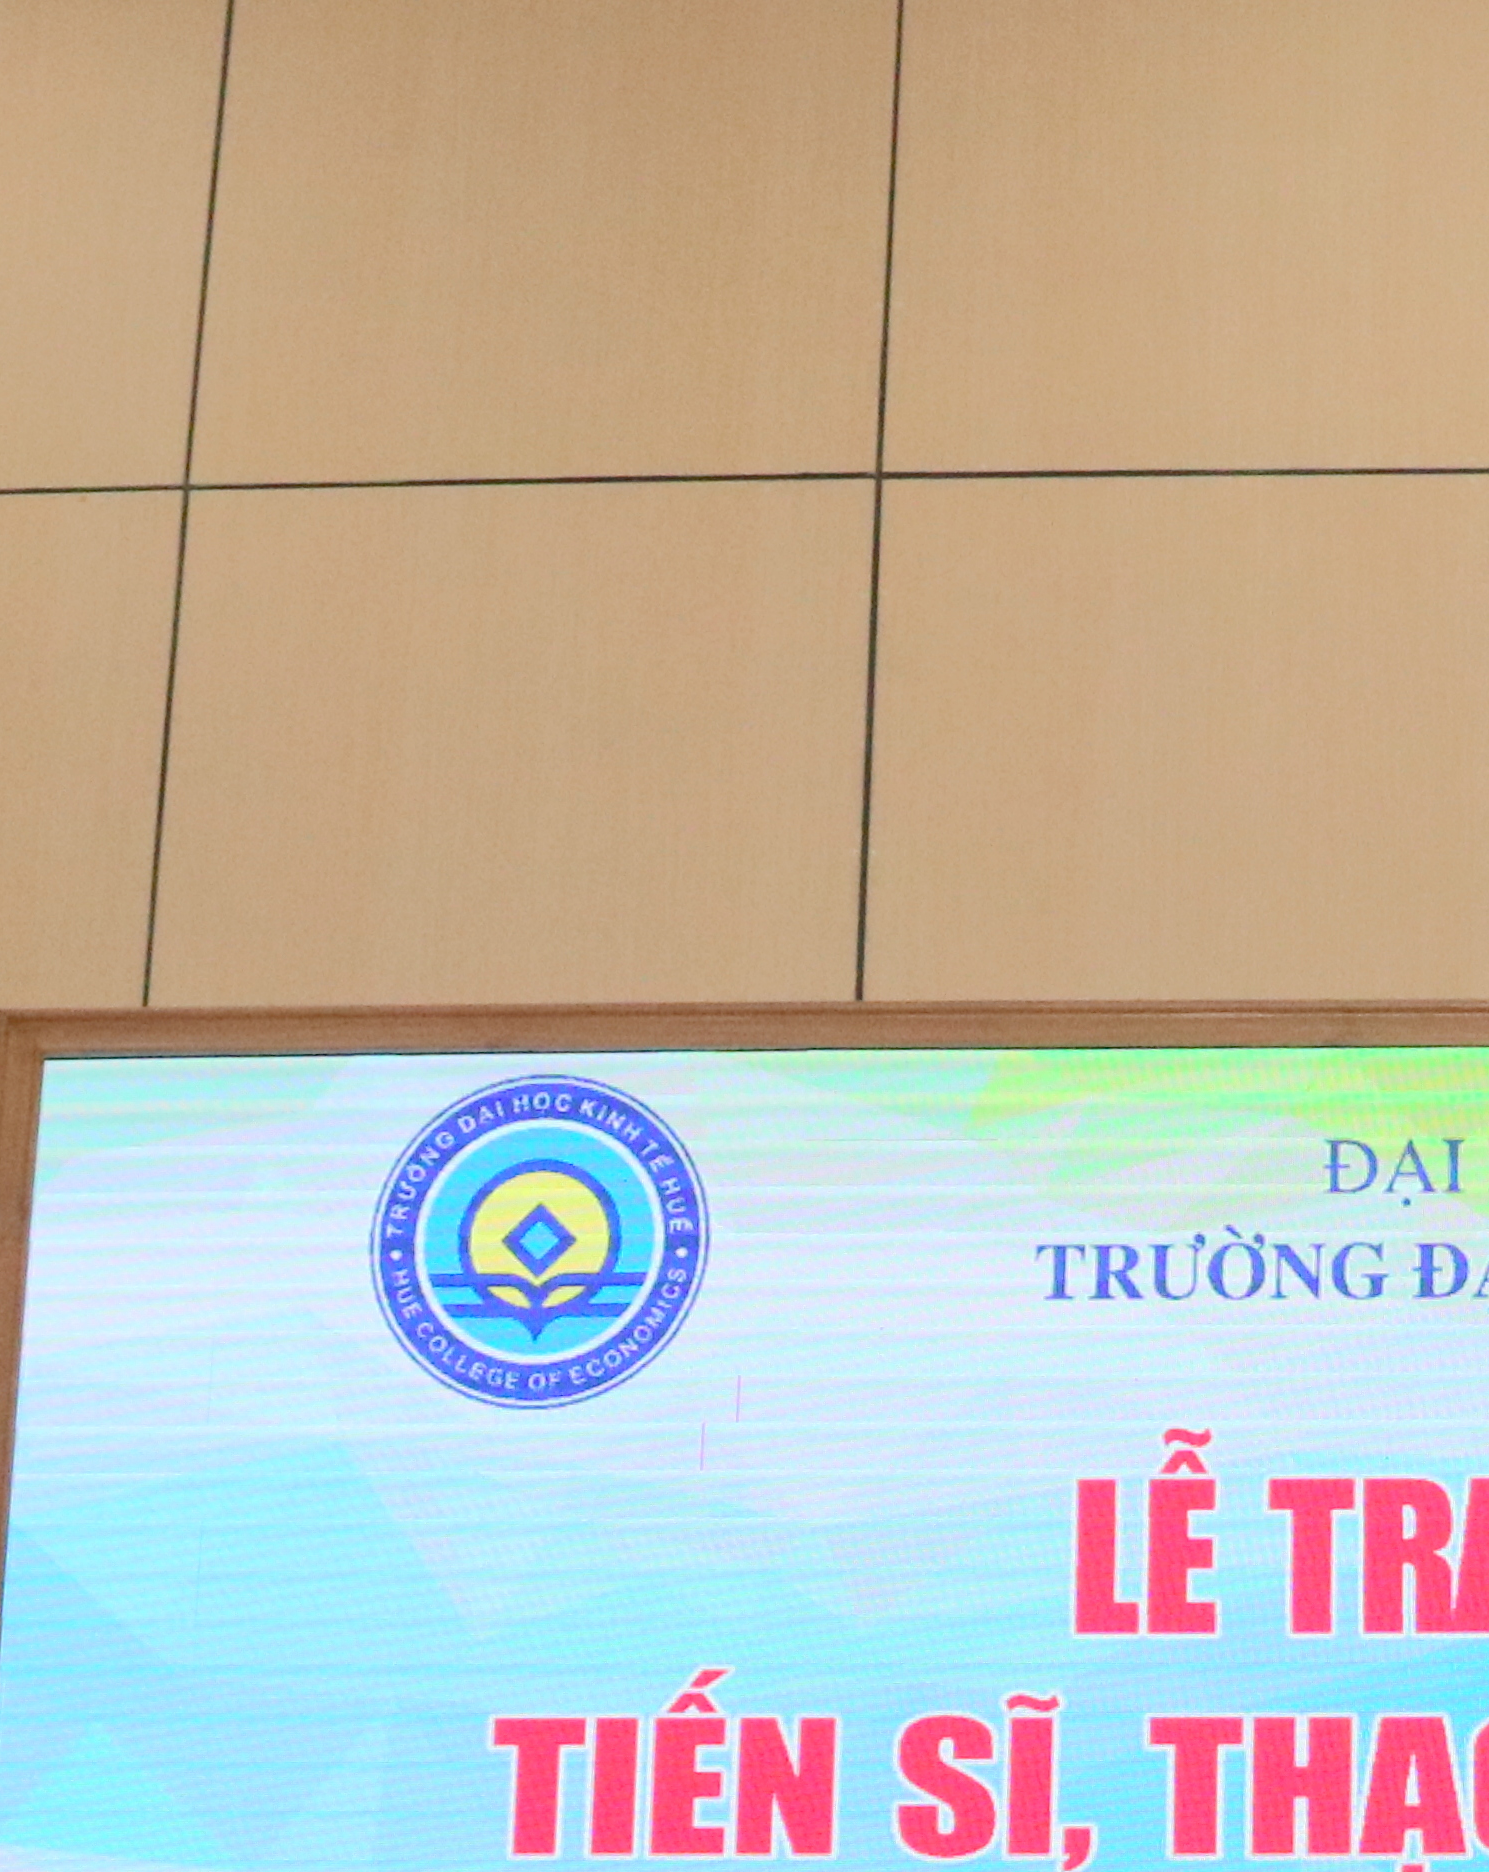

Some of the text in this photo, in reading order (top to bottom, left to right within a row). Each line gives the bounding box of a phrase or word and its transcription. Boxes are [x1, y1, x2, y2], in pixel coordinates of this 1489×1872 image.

[578, 1098, 646, 1143] KINH
[1324, 1138, 1465, 1206] ĐẠI
[1035, 1224, 1389, 1300] TRƯỜNG
[415, 1321, 521, 1391] COLLEGE
[528, 1370, 563, 1391] OF
[569, 1269, 688, 1385] ECONOMICS
[1072, 1427, 1219, 1636] LỄ
[491, 1668, 839, 1858] TIẾN
